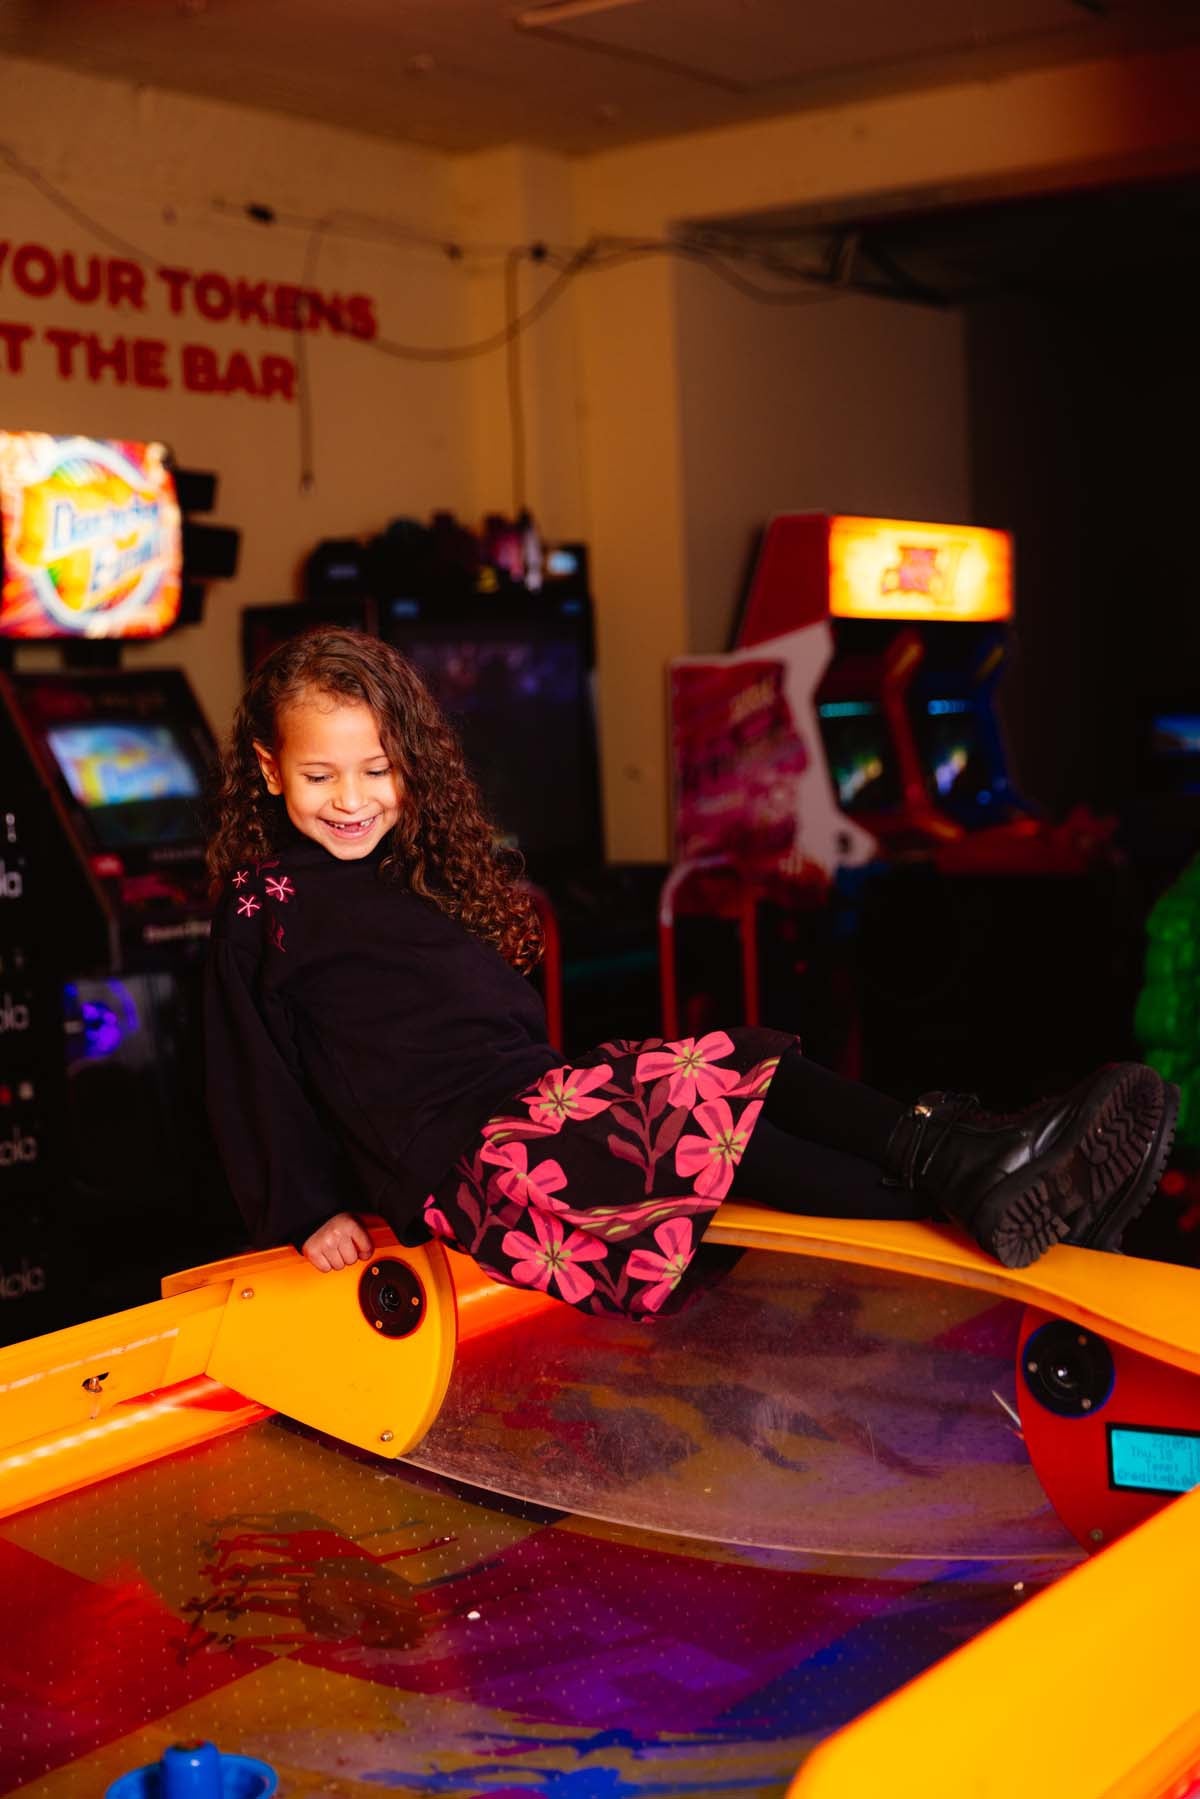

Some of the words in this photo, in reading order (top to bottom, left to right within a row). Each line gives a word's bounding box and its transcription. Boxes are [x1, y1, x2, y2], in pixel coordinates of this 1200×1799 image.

[0, 241, 147, 312] OUR
[157, 266, 379, 342] TOKENS
[44, 327, 172, 392] THE
[181, 344, 297, 402] BAR
